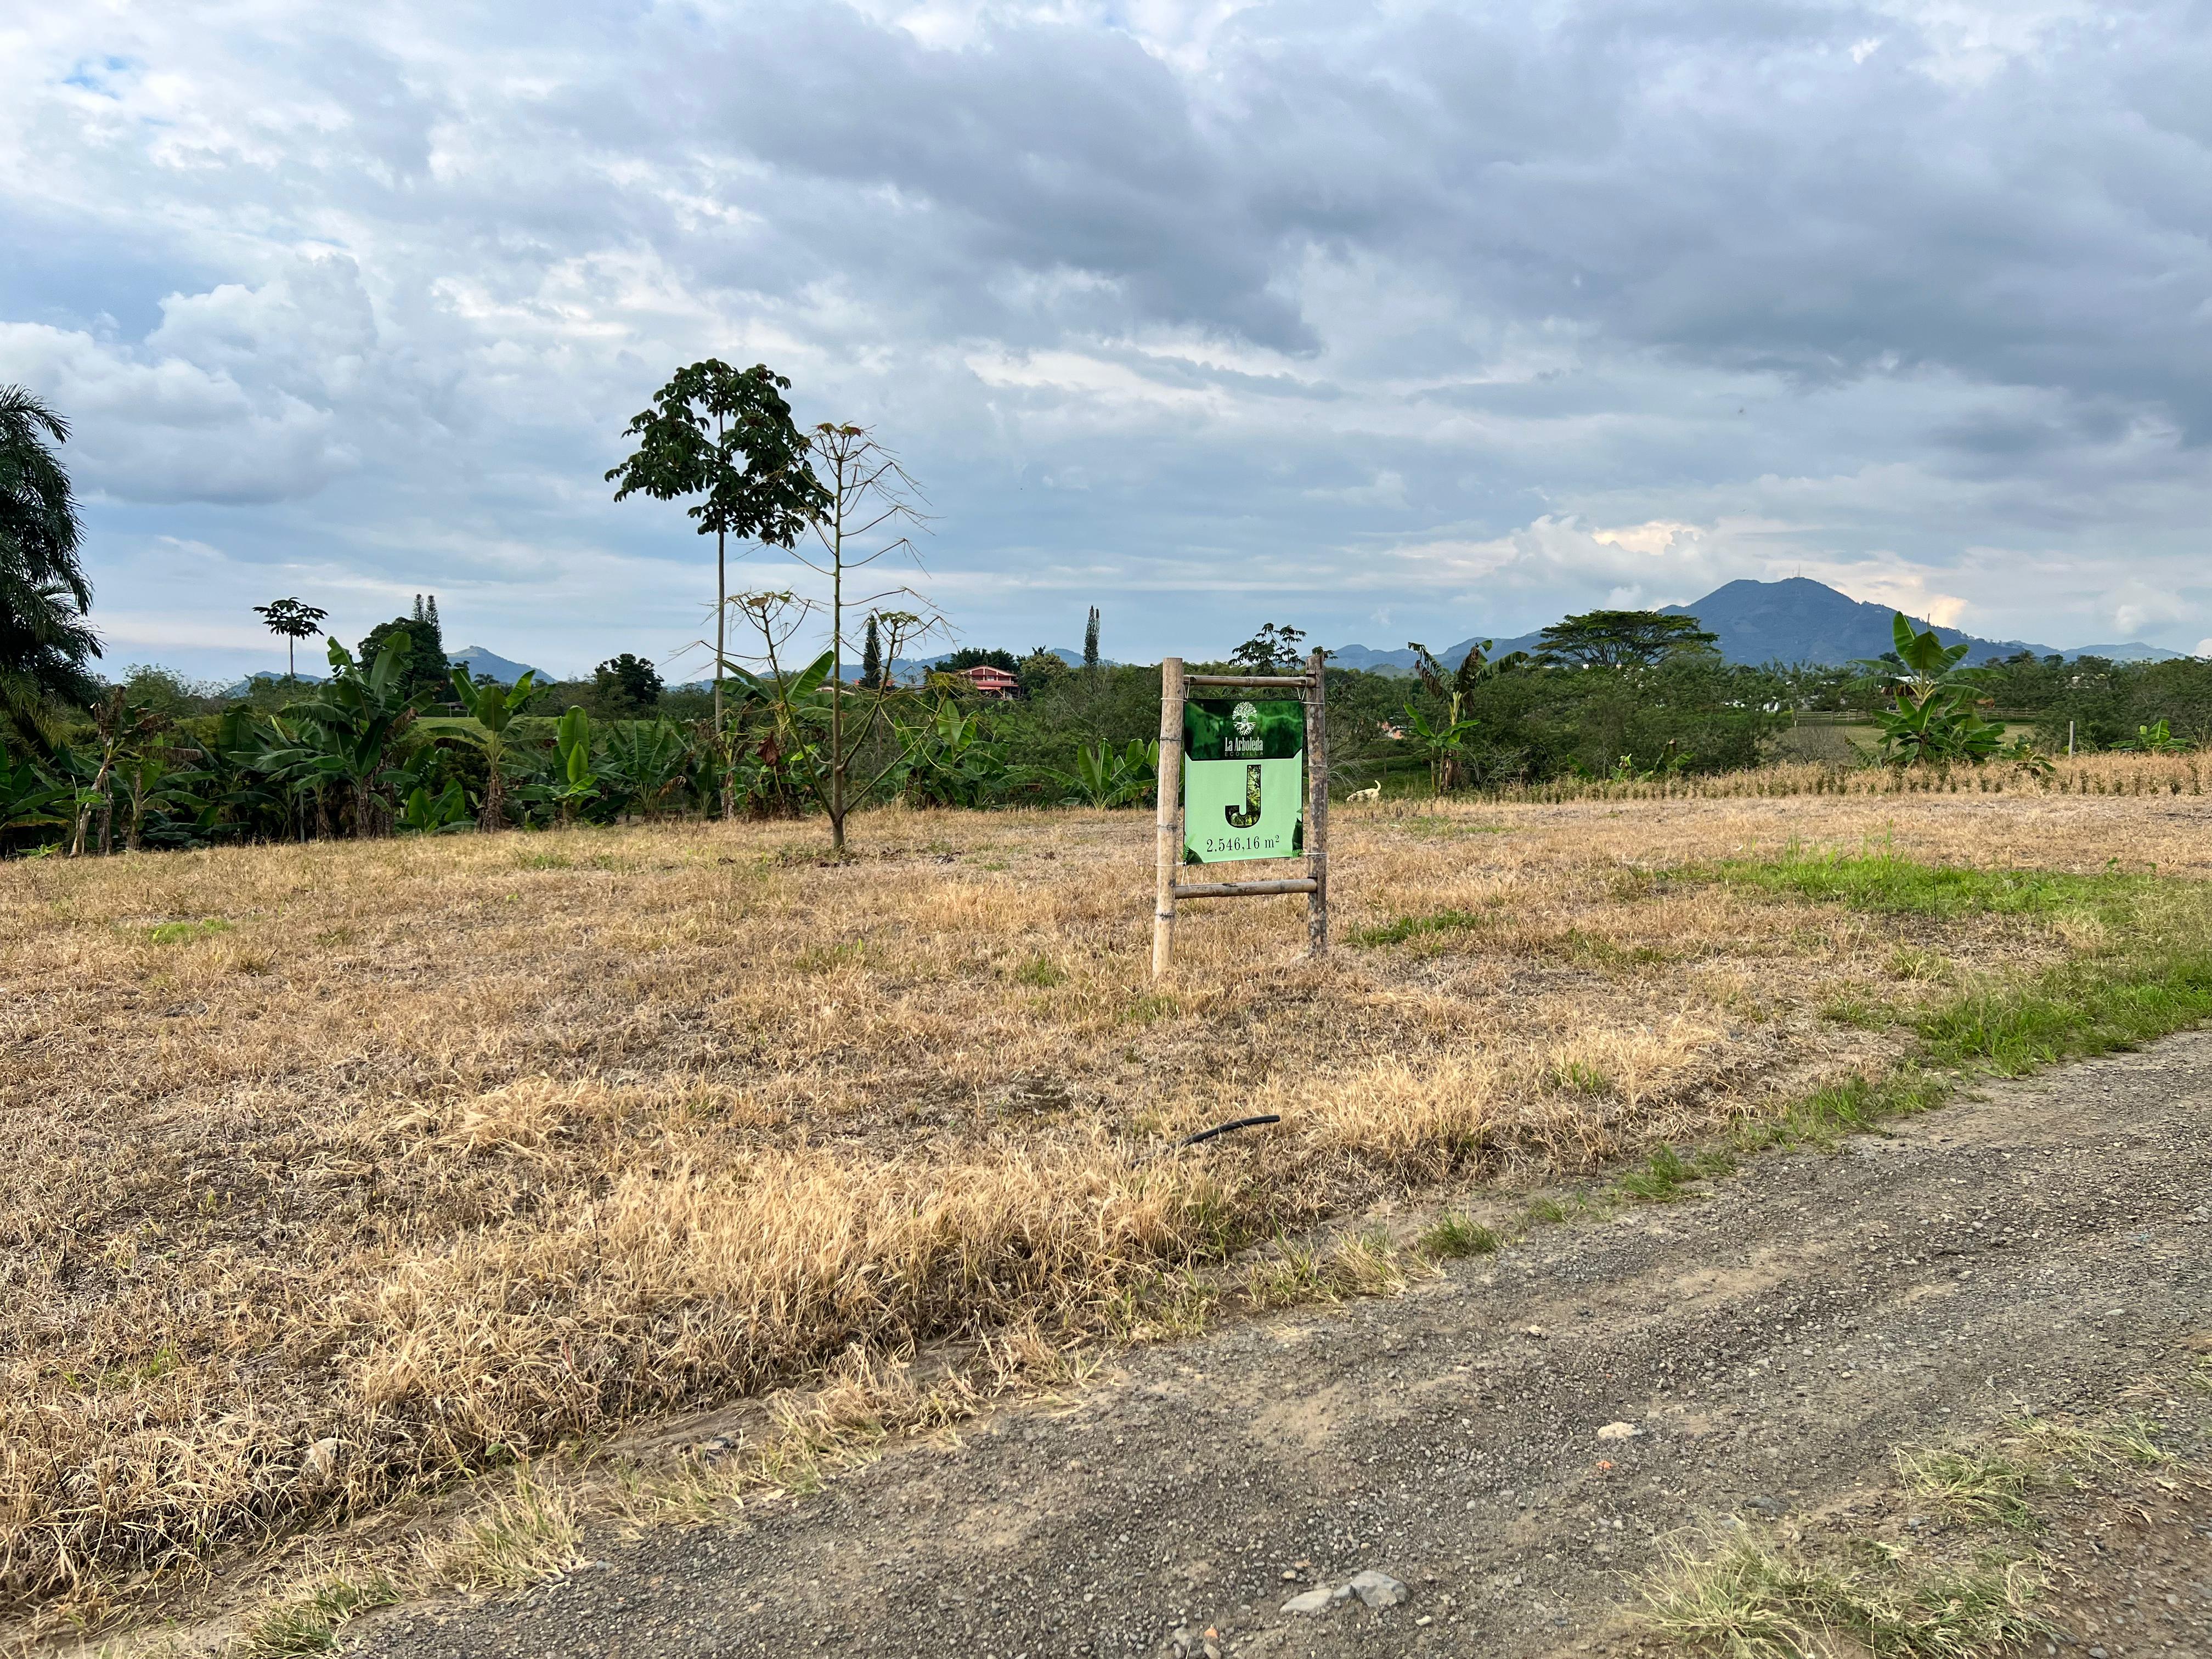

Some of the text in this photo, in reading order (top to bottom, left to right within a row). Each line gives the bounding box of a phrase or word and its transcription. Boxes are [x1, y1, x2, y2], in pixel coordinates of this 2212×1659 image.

[1225, 736, 1263, 752] La Arboleda
[1224, 764, 1262, 828] J
[1206, 836, 1260, 852] 2.546,16
